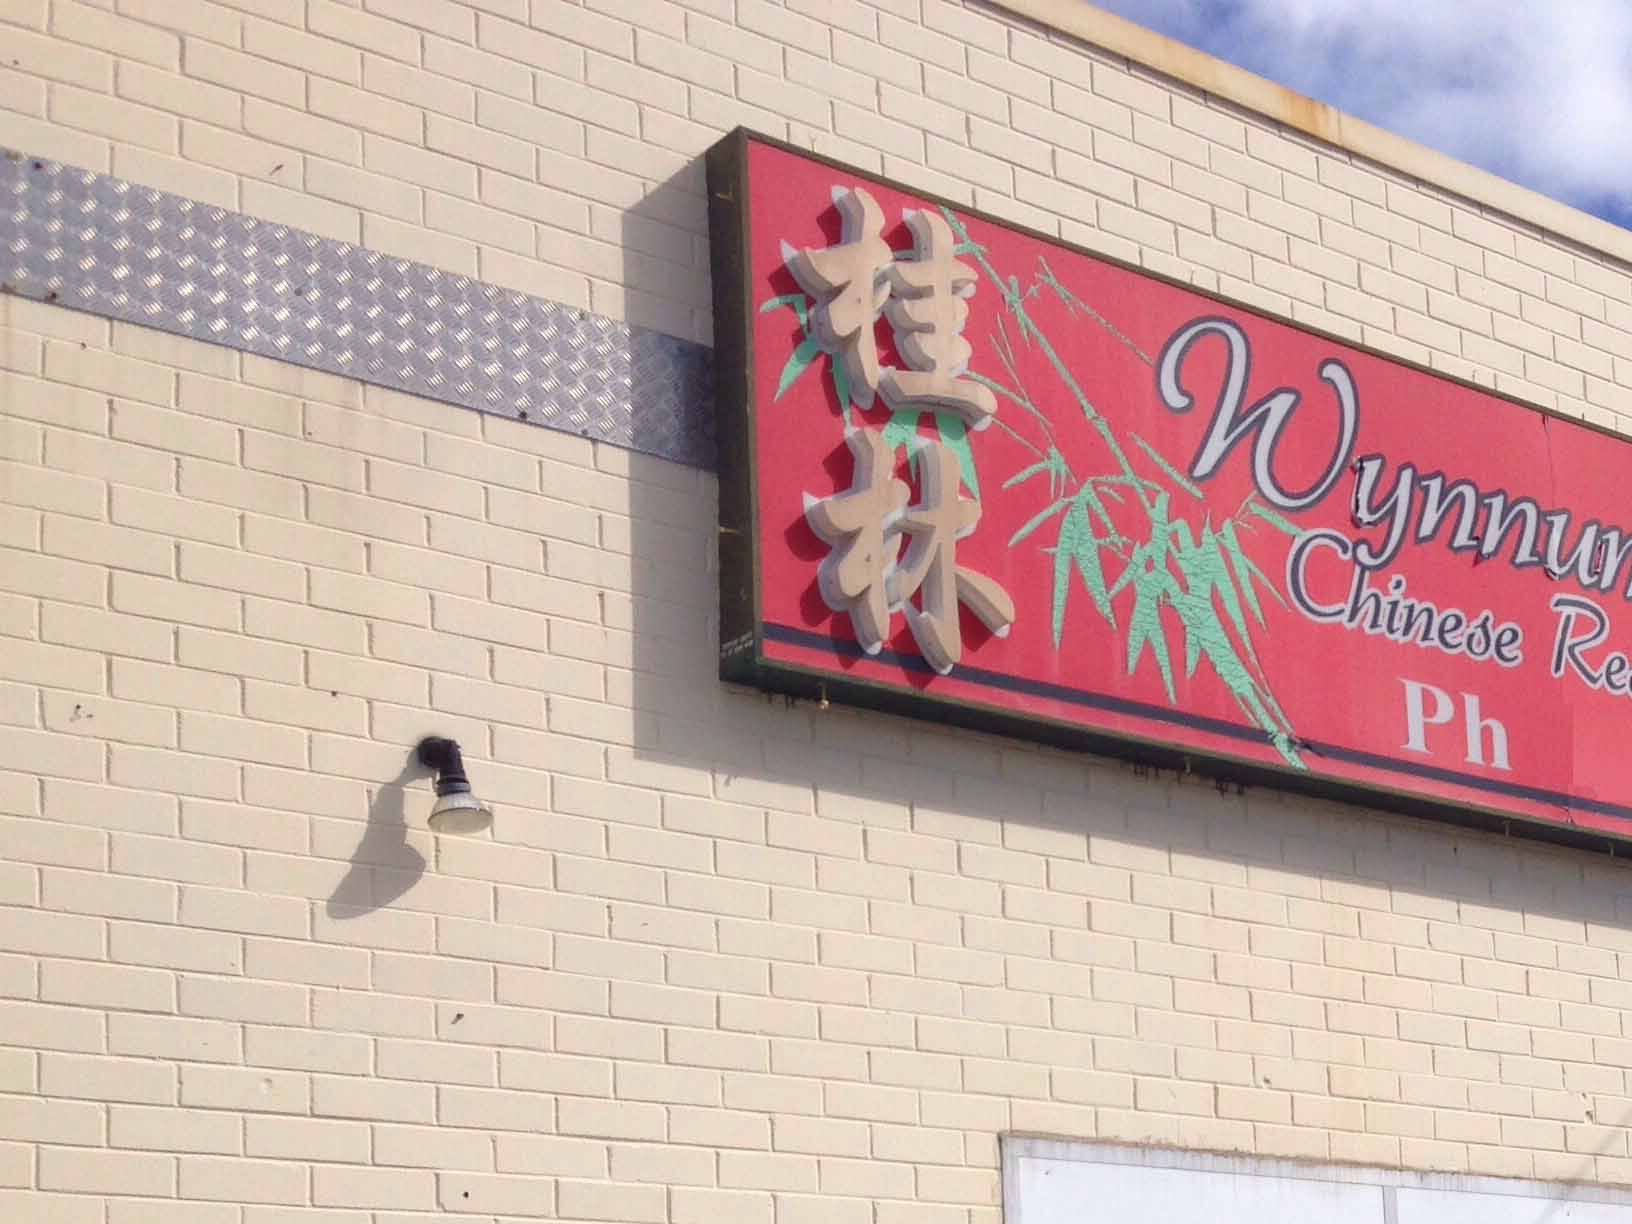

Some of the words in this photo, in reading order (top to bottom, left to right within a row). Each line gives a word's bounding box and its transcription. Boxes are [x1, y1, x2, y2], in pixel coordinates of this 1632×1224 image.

[782, 186, 1016, 674] 桂林
[1286, 528, 1524, 667] Chinese
[1398, 677, 1512, 771] Ph
